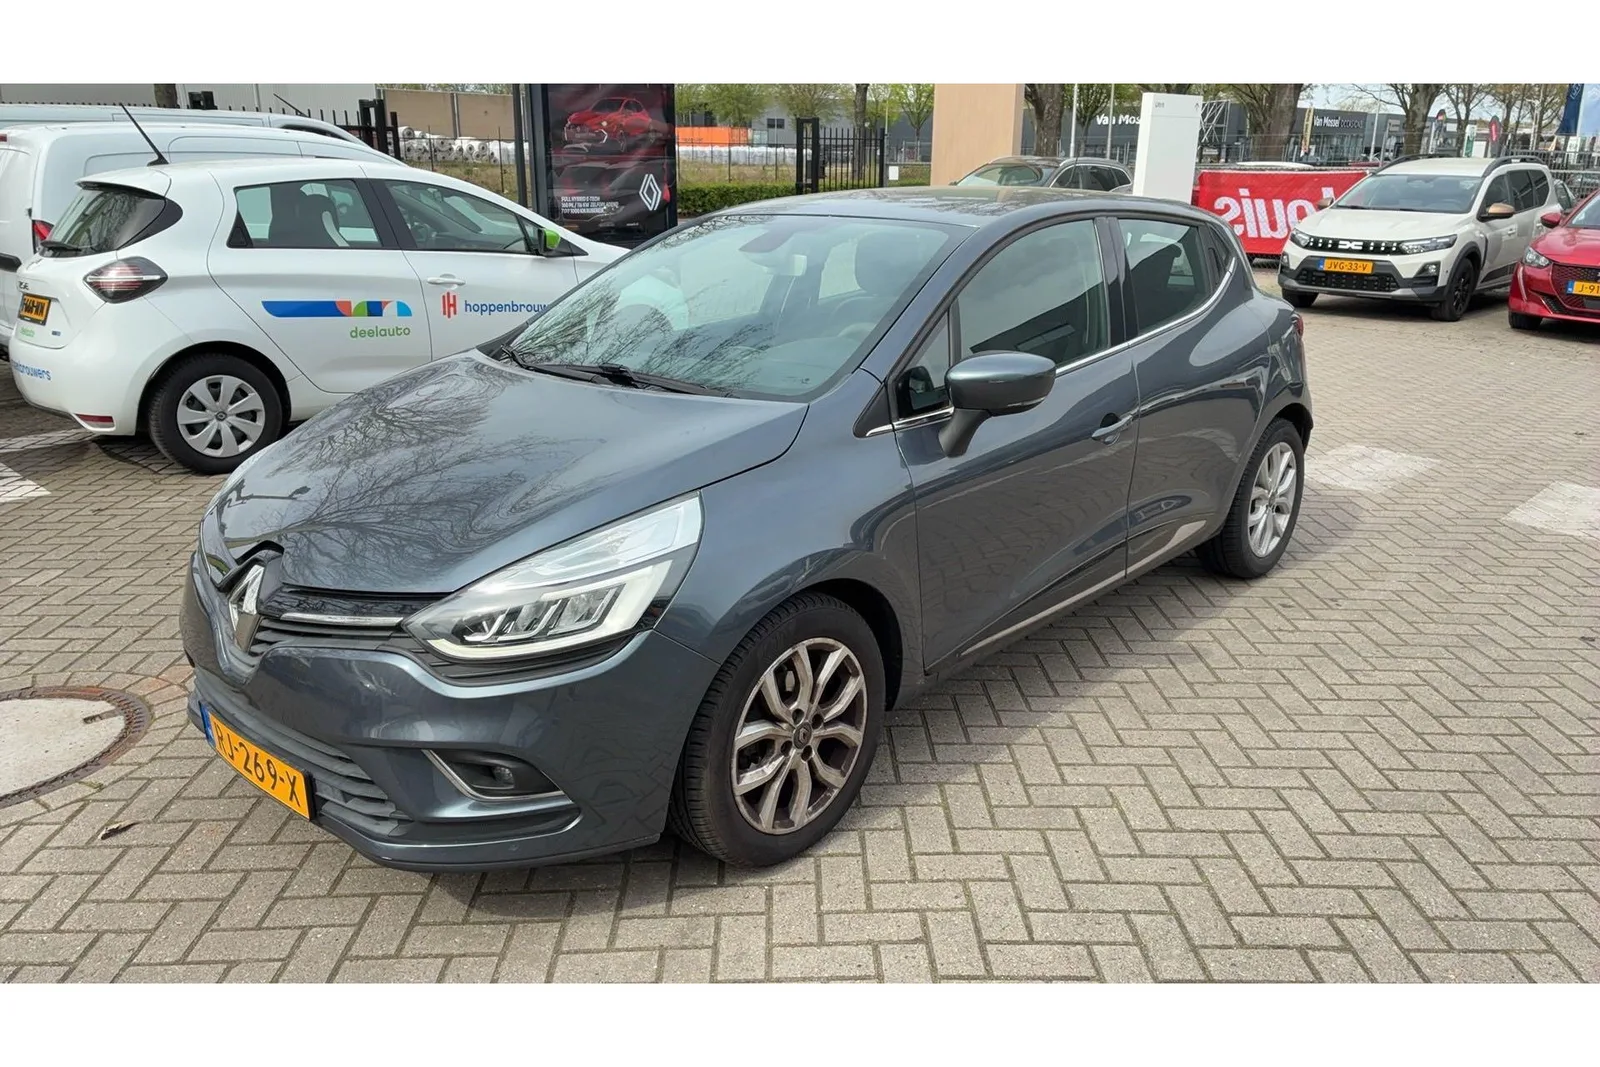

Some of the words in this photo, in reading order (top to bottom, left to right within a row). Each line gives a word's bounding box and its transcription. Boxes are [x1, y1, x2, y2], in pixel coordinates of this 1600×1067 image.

[1313, 115, 1323, 127] Van
[1323, 116, 1341, 128] Mossel
[1327, 261, 1369, 272] JVG-33-V
[350, 325, 411, 338] deelauto
[213, 721, 301, 808] RJ-269-X
